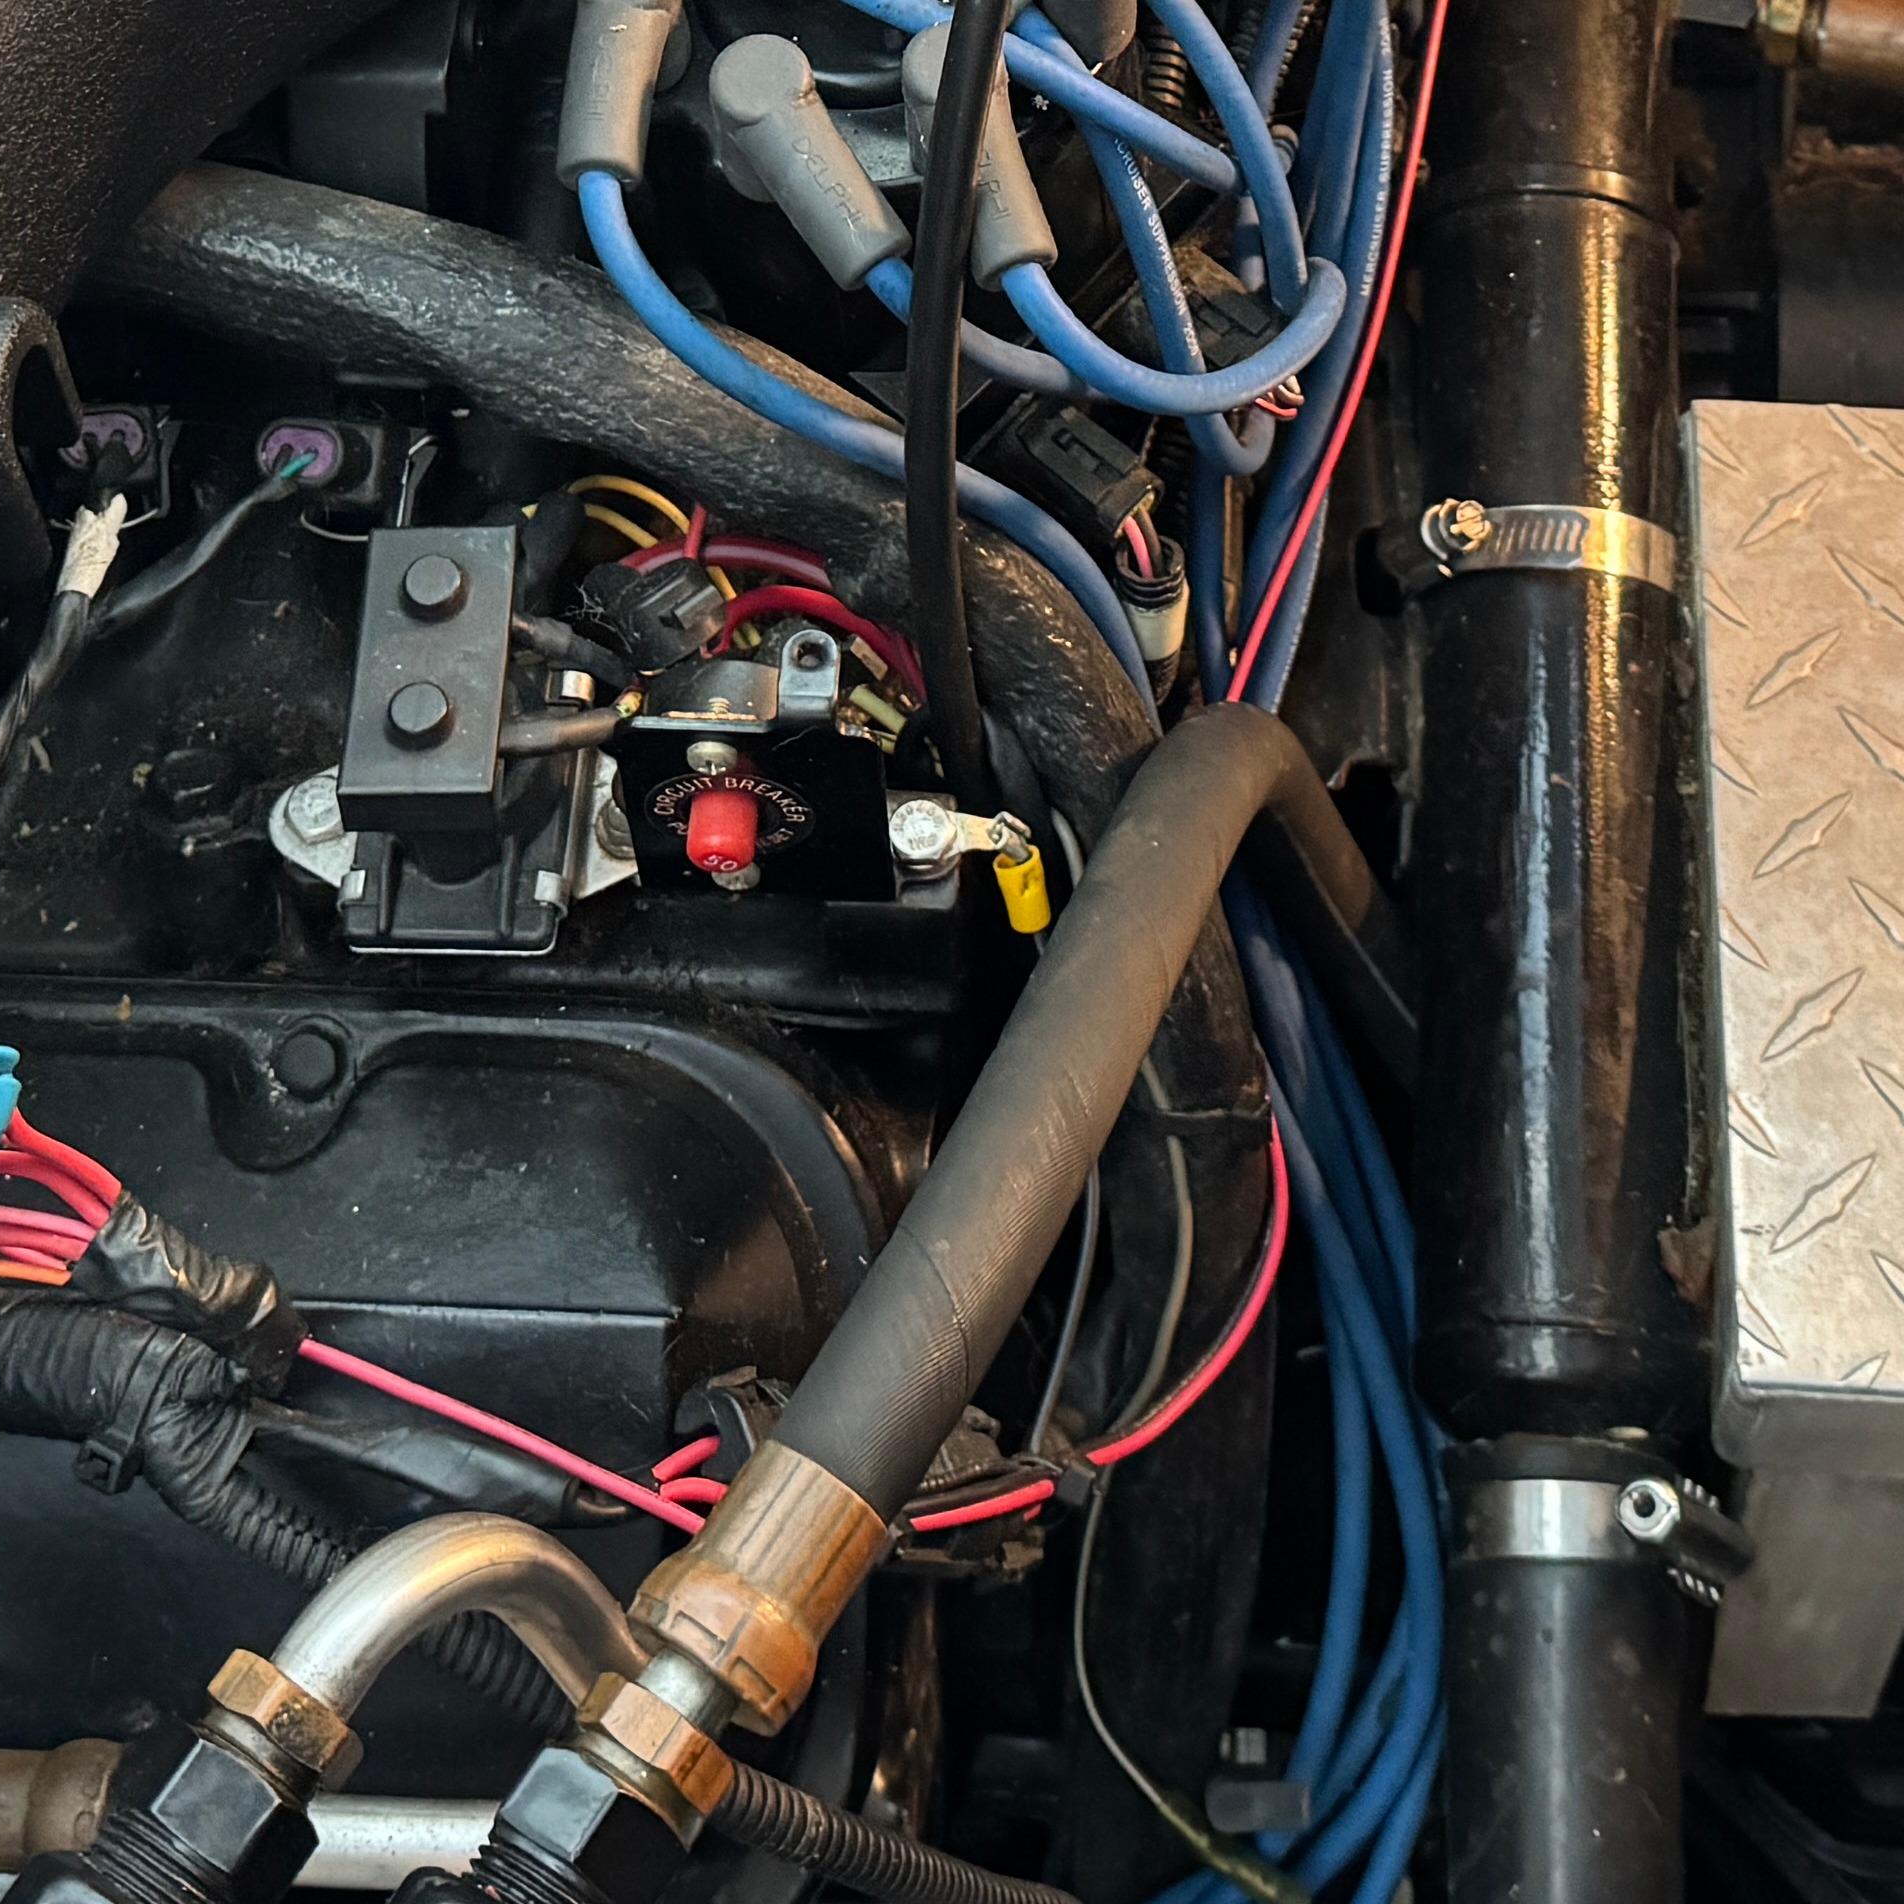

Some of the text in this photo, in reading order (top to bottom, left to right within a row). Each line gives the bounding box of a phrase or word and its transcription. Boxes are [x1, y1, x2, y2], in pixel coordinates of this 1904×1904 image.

[1146, 213, 1189, 316] SUPPRESSION
[653, 776, 807, 823] CIRCUIT BREAKER
[703, 854, 738, 872] 50
